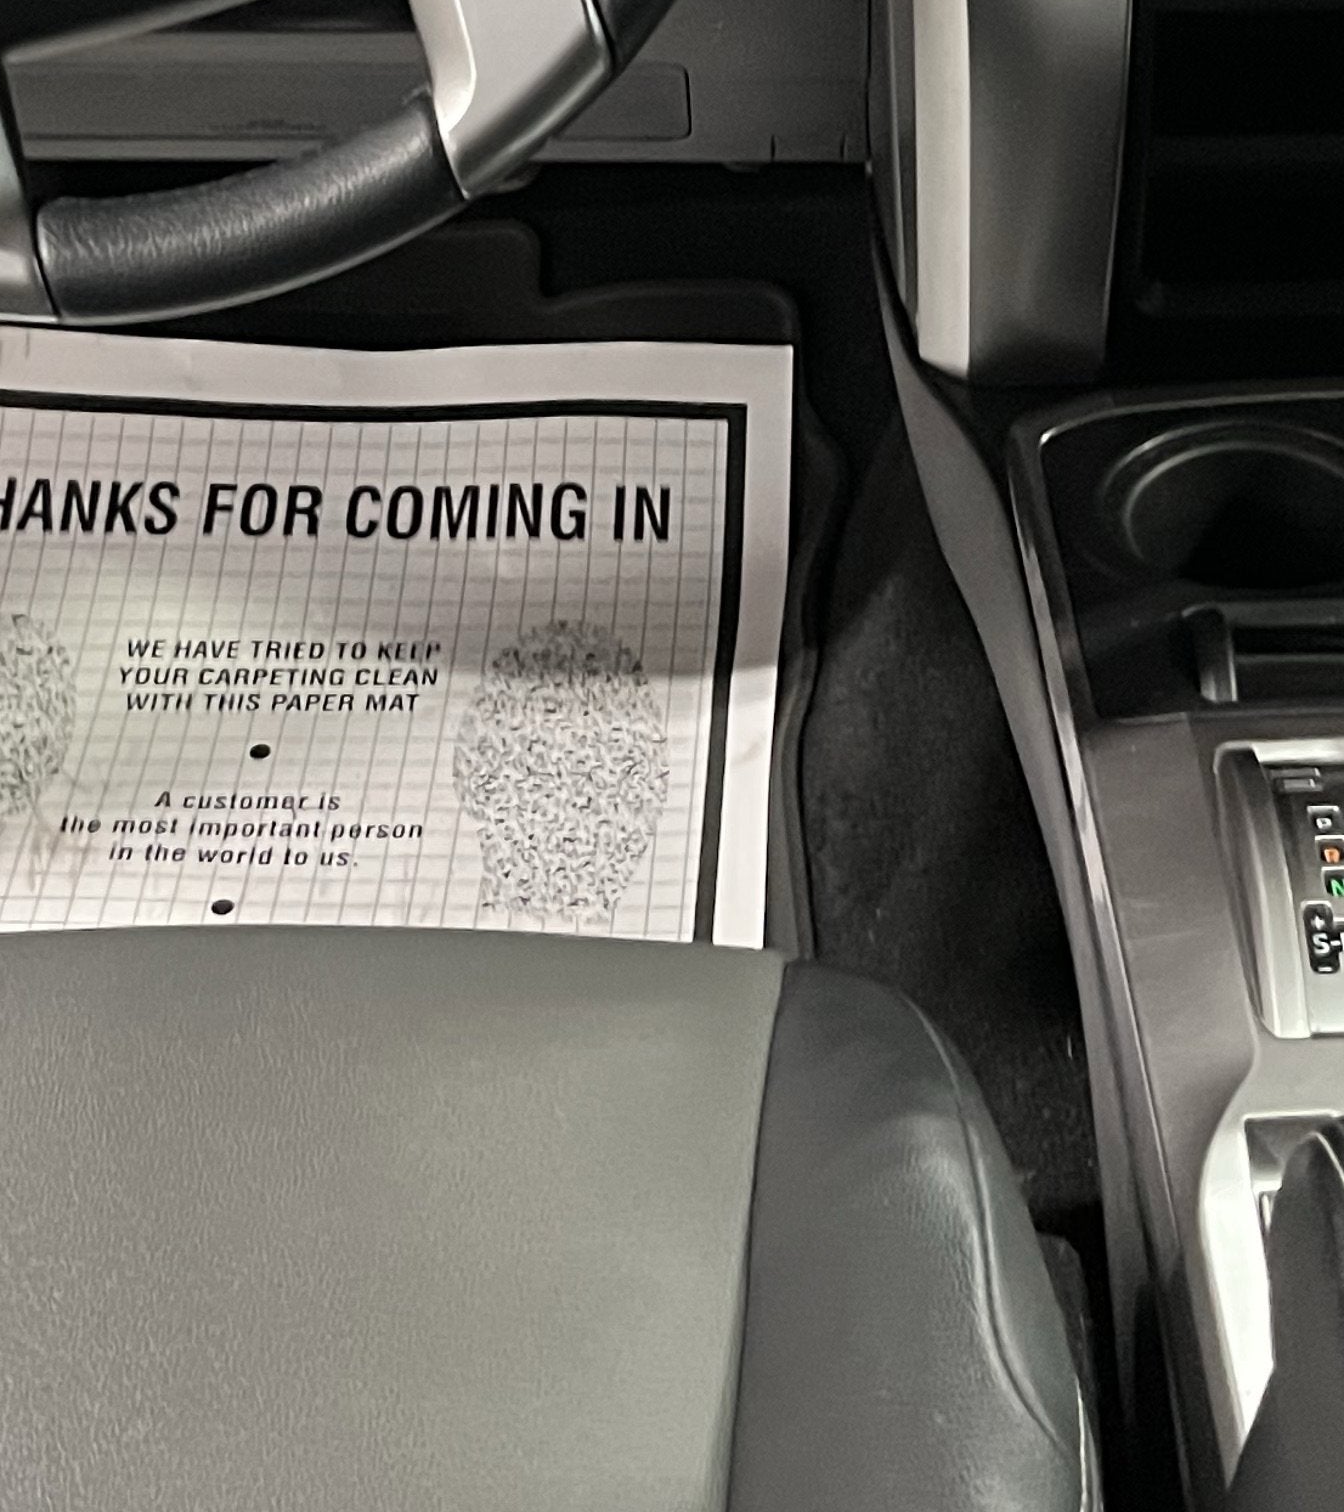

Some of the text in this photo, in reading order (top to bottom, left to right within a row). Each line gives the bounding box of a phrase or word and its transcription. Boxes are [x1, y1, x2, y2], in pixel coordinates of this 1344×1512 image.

[203, 483, 323, 537] FOR
[345, 482, 587, 541] COMING
[614, 484, 670, 542] IN
[127, 639, 166, 659] WE
[174, 639, 240, 660] HAVE
[251, 640, 325, 660] TRIED
[337, 641, 367, 660] TO
[120, 667, 438, 687] YOUR CARPETING CLEAN
[126, 693, 419, 712] WITH THIS PAPER MAT
[154, 791, 341, 811] A customer is
[60, 816, 423, 841] the most important person
[109, 843, 132, 861] in
[144, 844, 186, 863] the
[198, 846, 272, 866] world
[283, 848, 308, 866] to
